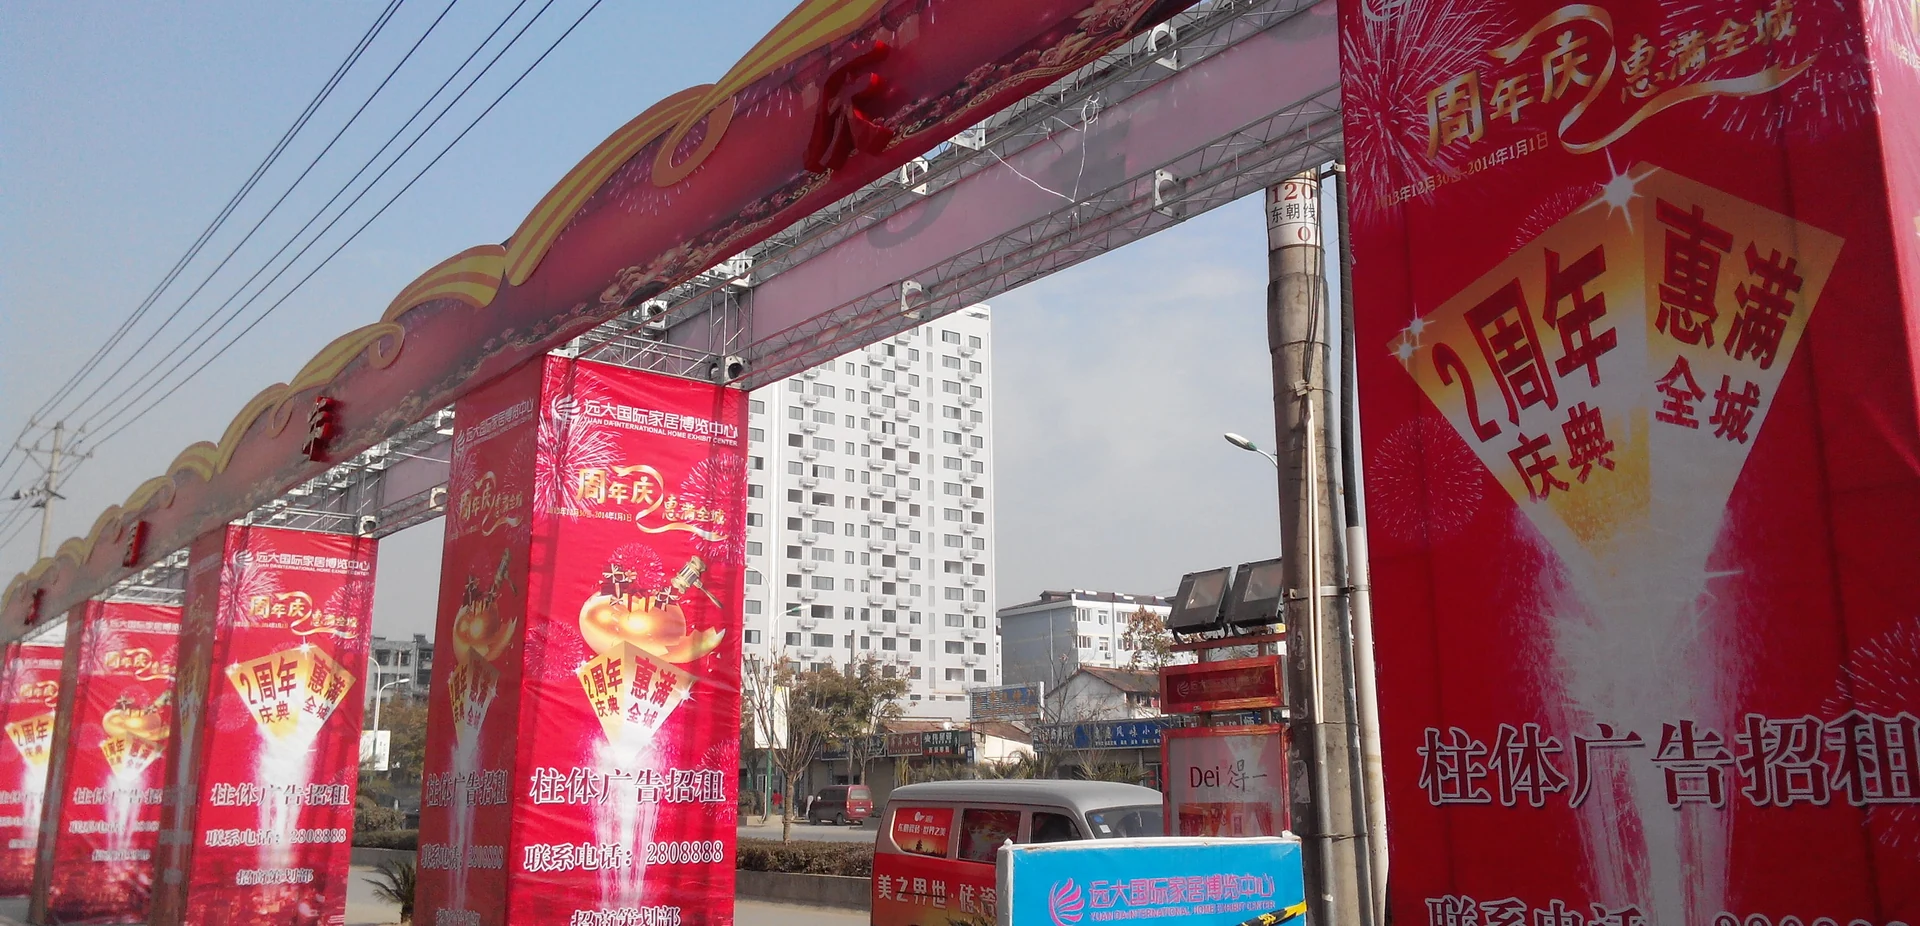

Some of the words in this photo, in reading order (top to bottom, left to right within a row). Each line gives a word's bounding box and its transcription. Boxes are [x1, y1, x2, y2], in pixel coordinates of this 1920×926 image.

[1620, 0, 1797, 104] 惠满全城
[1427, 30, 1597, 160] 周年庆
[1271, 183, 1313, 204] 120
[1271, 203, 1316, 223] 东朝线
[1655, 197, 1803, 371] 惠满
[1431, 244, 1618, 443] 2周年
[1655, 355, 1762, 446] 全城
[583, 399, 739, 439] 远大国际家居博览中心
[667, 430, 687, 439] HOME
[687, 433, 712, 443] EXHIBIT
[713, 437, 738, 447] CENTER
[1507, 401, 1616, 503] 庆典
[576, 468, 654, 505] 周年庆
[662, 494, 726, 525] 惠满全城
[256, 551, 370, 572] 远大国际家居博览中心
[249, 596, 305, 618] 周年庆
[239, 656, 298, 705] 2周年
[308, 654, 346, 704] 惠满
[583, 658, 623, 699] 2周年
[630, 655, 677, 708] 惠满
[259, 701, 290, 724] 庆典
[303, 695, 330, 720] 全城
[595, 695, 620, 717] 庆典
[626, 702, 658, 729] 全城
[1417, 709, 1920, 809] 柱体广告招租
[529, 766, 726, 804] 柱体广告招租
[1190, 766, 1219, 788] Dei
[210, 783, 350, 806] 柱体广告招租
[290, 828, 346, 844] 2808888
[646, 840, 724, 865] 2808888
[1088, 873, 1275, 908] 远大国际家居博览中心
[1090, 911, 1113, 922] YUAN
[1193, 904, 1217, 915] HOME
[1217, 902, 1245, 913] EXHIBIT
[1246, 900, 1276, 910] CENTER
